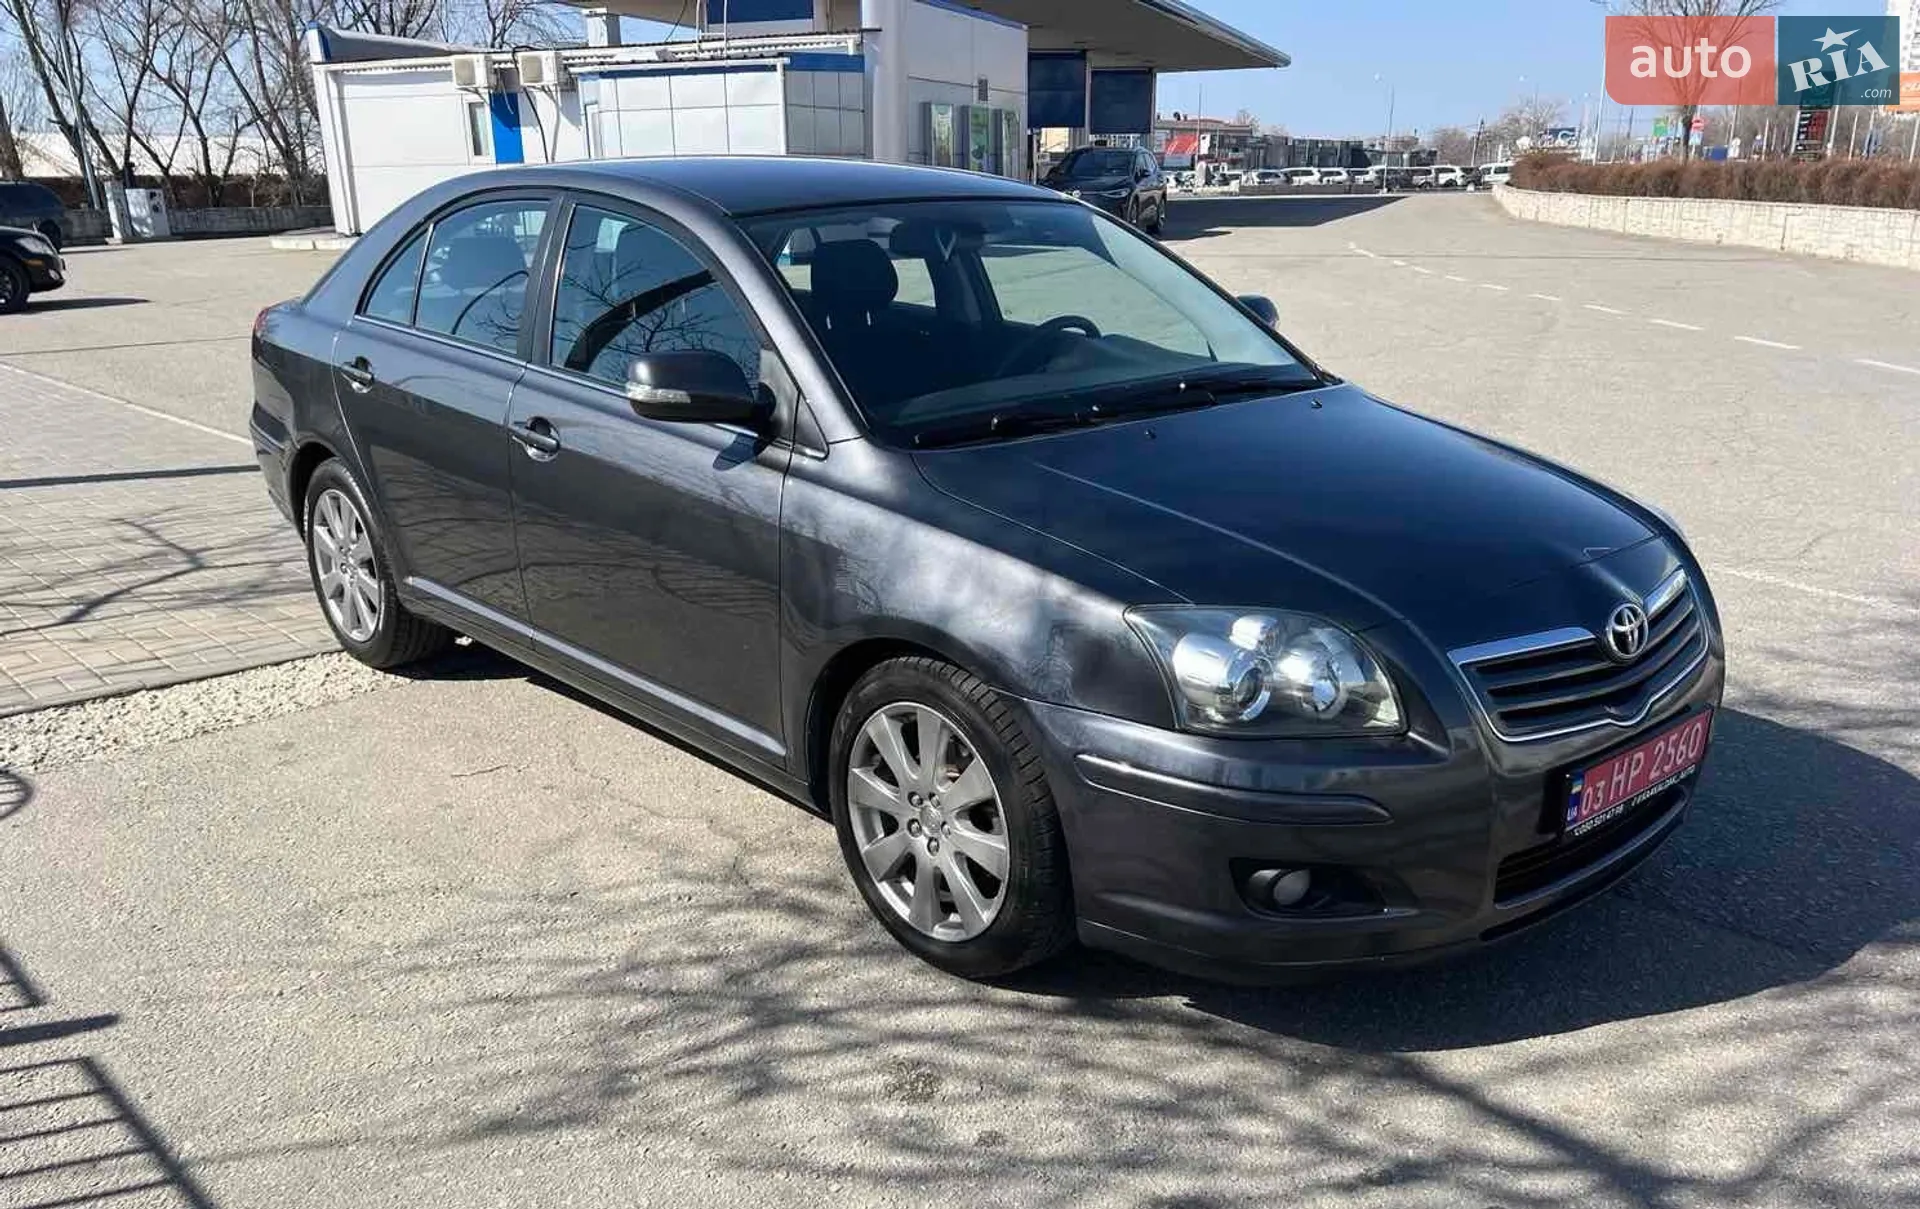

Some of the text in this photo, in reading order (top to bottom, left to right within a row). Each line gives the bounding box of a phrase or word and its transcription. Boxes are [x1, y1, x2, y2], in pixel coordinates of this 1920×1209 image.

[1581, 781, 1606, 816] 03
[1610, 751, 1644, 801] HP
[1649, 722, 1702, 781] 2560
